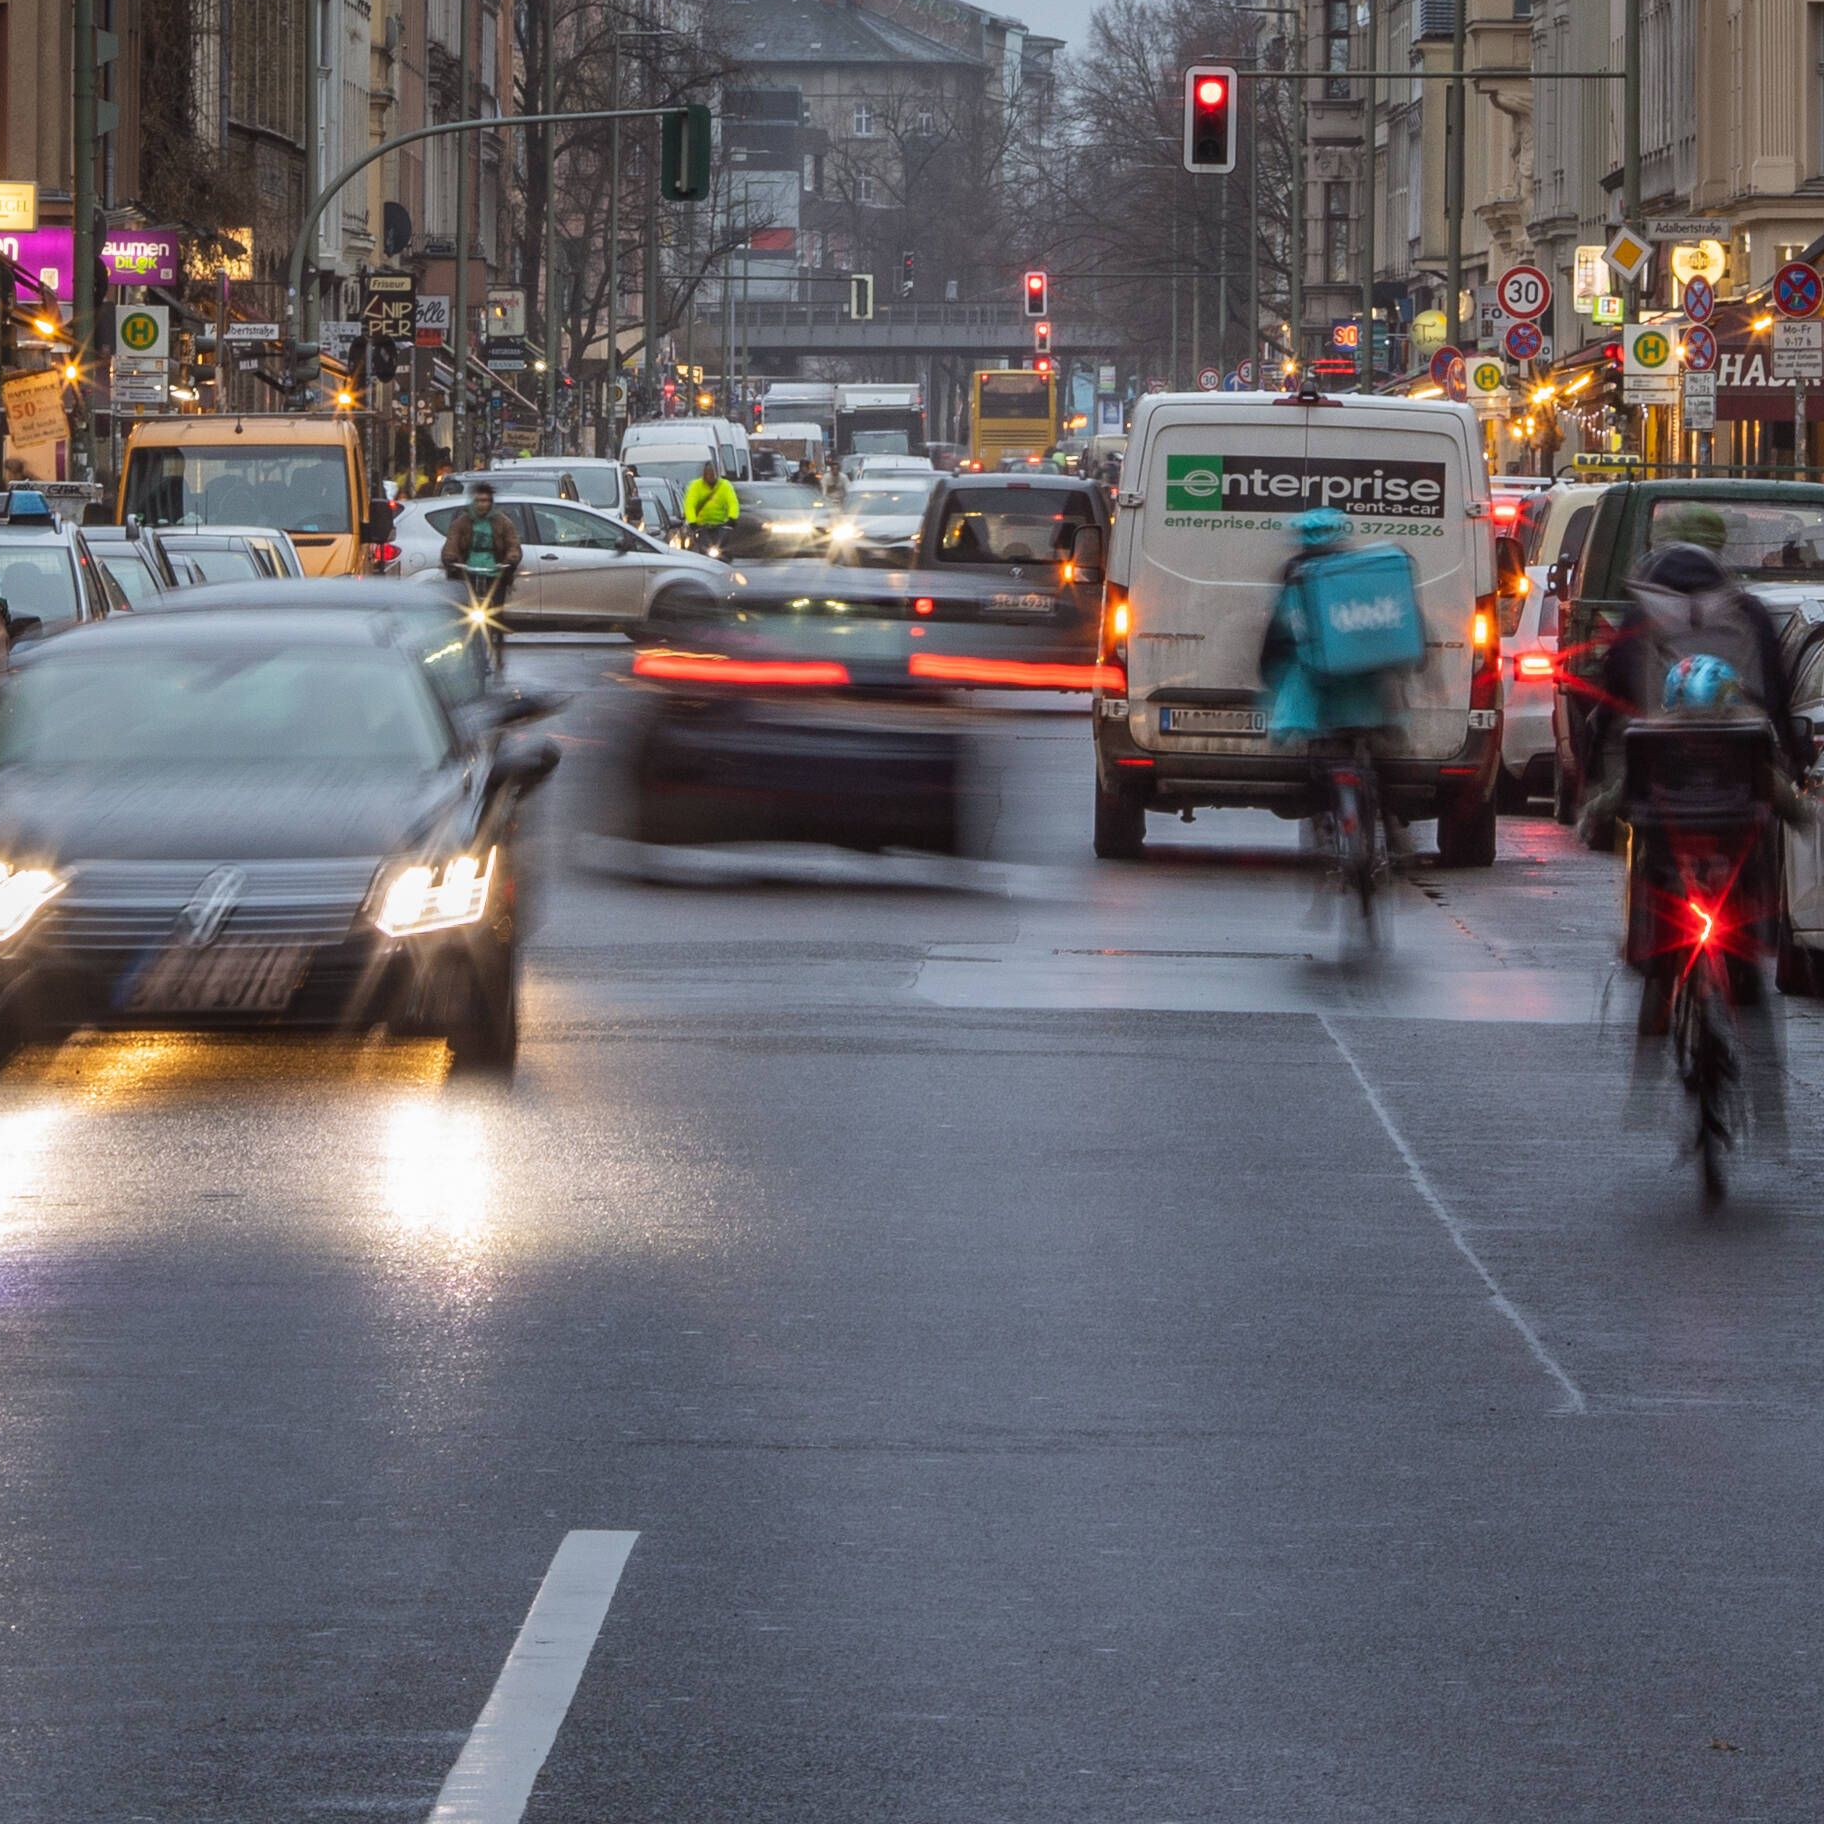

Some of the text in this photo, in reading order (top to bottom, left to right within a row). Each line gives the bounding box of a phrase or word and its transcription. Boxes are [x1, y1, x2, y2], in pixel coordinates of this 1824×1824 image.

[1655, 221, 1721, 235] Adalbertstraße
[1509, 280, 1539, 304] 30
[1481, 308, 1510, 319] FO
[210, 325, 275, 337] Abertstraße
[1166, 469, 1441, 506] enterprise
[1346, 501, 1440, 516] rent-a-car
[1164, 516, 1282, 532] enterprise.de
[1360, 522, 1445, 537] 3722826
